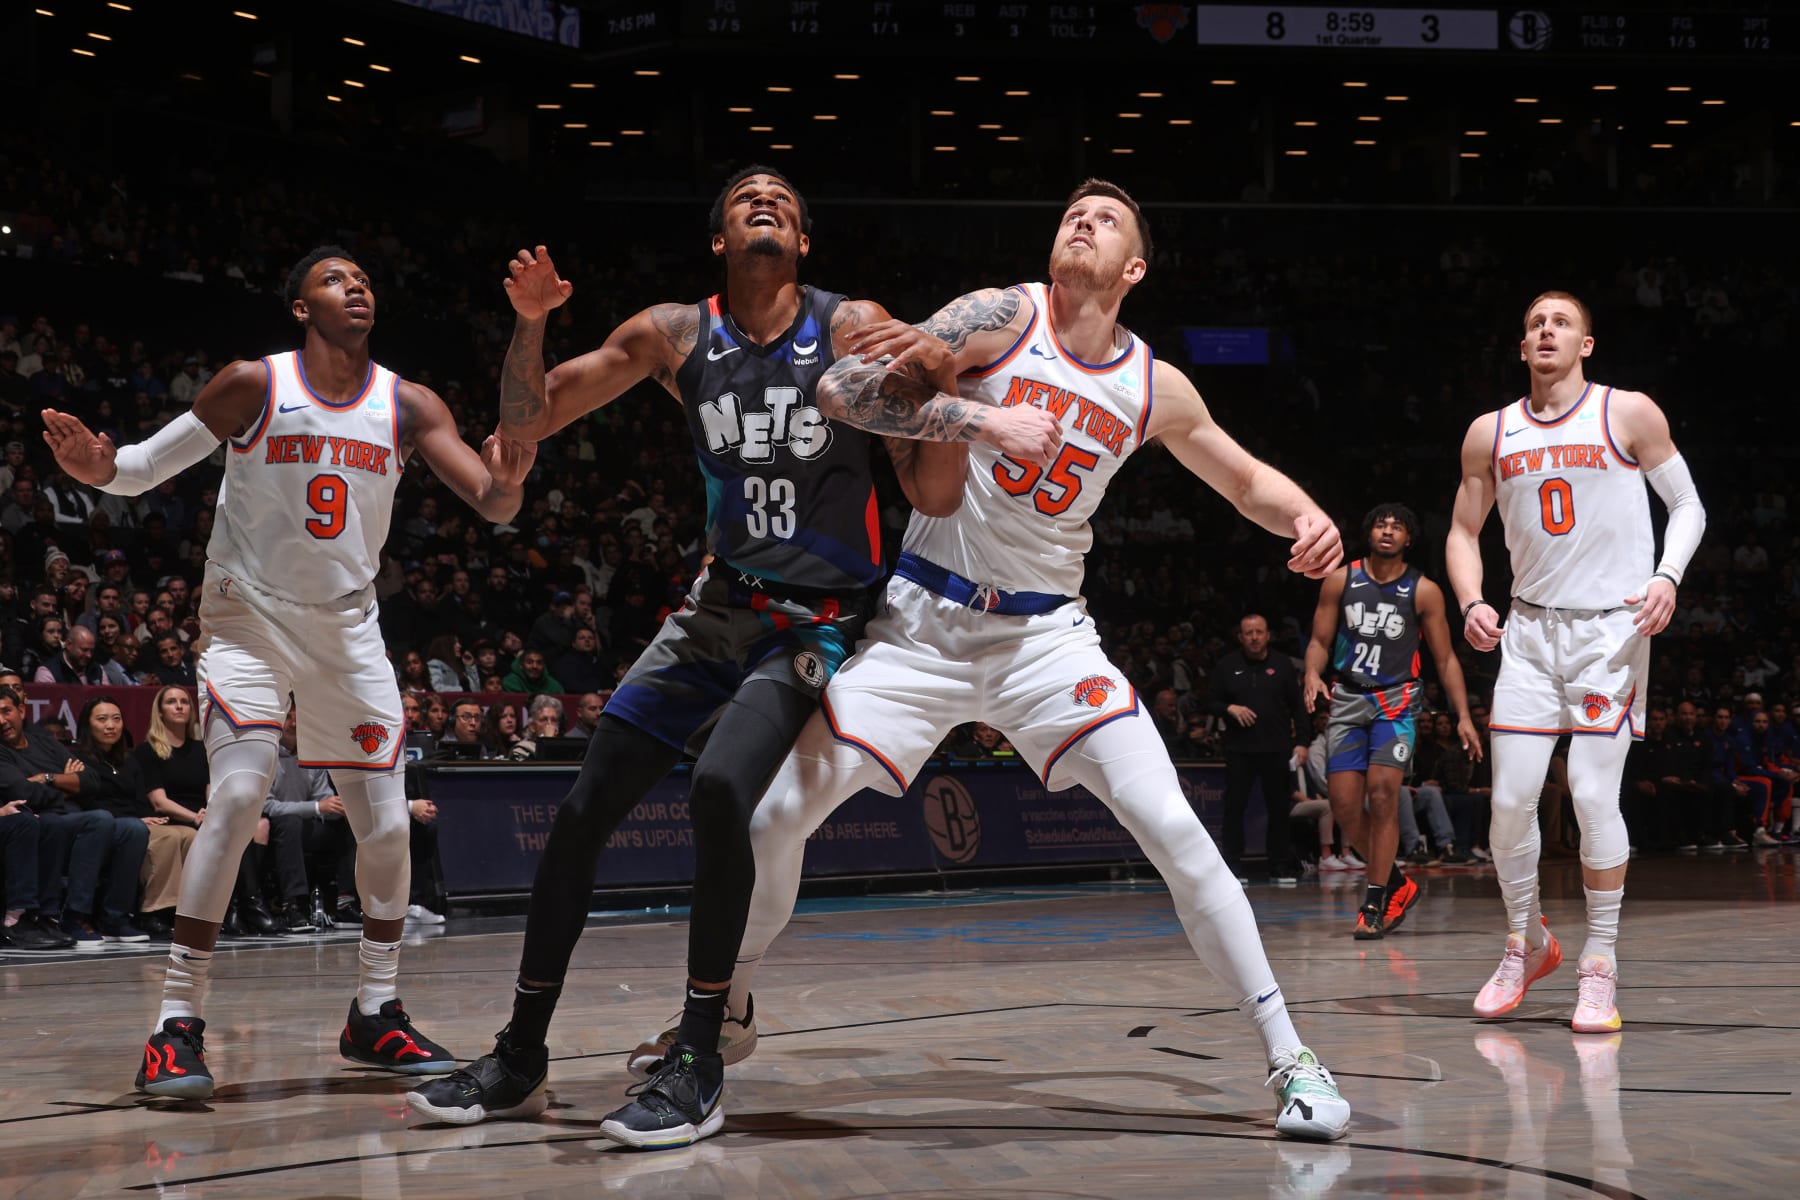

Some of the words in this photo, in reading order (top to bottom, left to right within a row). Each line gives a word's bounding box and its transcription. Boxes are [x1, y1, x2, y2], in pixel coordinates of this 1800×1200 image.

[874, 1, 892, 15] FT
[944, 4, 976, 17] REB
[1000, 5, 1028, 18] AST
[608, 16, 633, 35] 7:45
[636, 13, 656, 32] PM
[954, 24, 965, 37] 3
[1009, 25, 1020, 38] 3
[1089, 26, 1098, 38] 7
[1266, 12, 1285, 40] 8
[1325, 12, 1375, 32] 8:59
[1420, 15, 1440, 43] 3
[1616, 17, 1626, 29] 0
[1671, 17, 1693, 30] FG
[1743, 18, 1769, 31] 3PT
[1316, 34, 1335, 45] 1st
[1337, 34, 1382, 46] Quarter
[1615, 35, 1626, 48] 7
[794, 357, 820, 367] Webull
[1001, 376, 1074, 424] NEW
[1072, 395, 1132, 458] YORK
[265, 435, 327, 465] NEW
[328, 436, 391, 476] YORK
[1499, 447, 1546, 482] NEW
[1547, 444, 1608, 471] YORK
[305, 473, 349, 539] 9
[743, 476, 797, 540] 33
[1538, 477, 1576, 537] 0
[1351, 643, 1382, 676] 24
[510, 804, 546, 824] THE
[645, 829, 694, 848] UPDAT
[836, 822, 863, 840] ARE
[863, 821, 903, 839] HERE.
